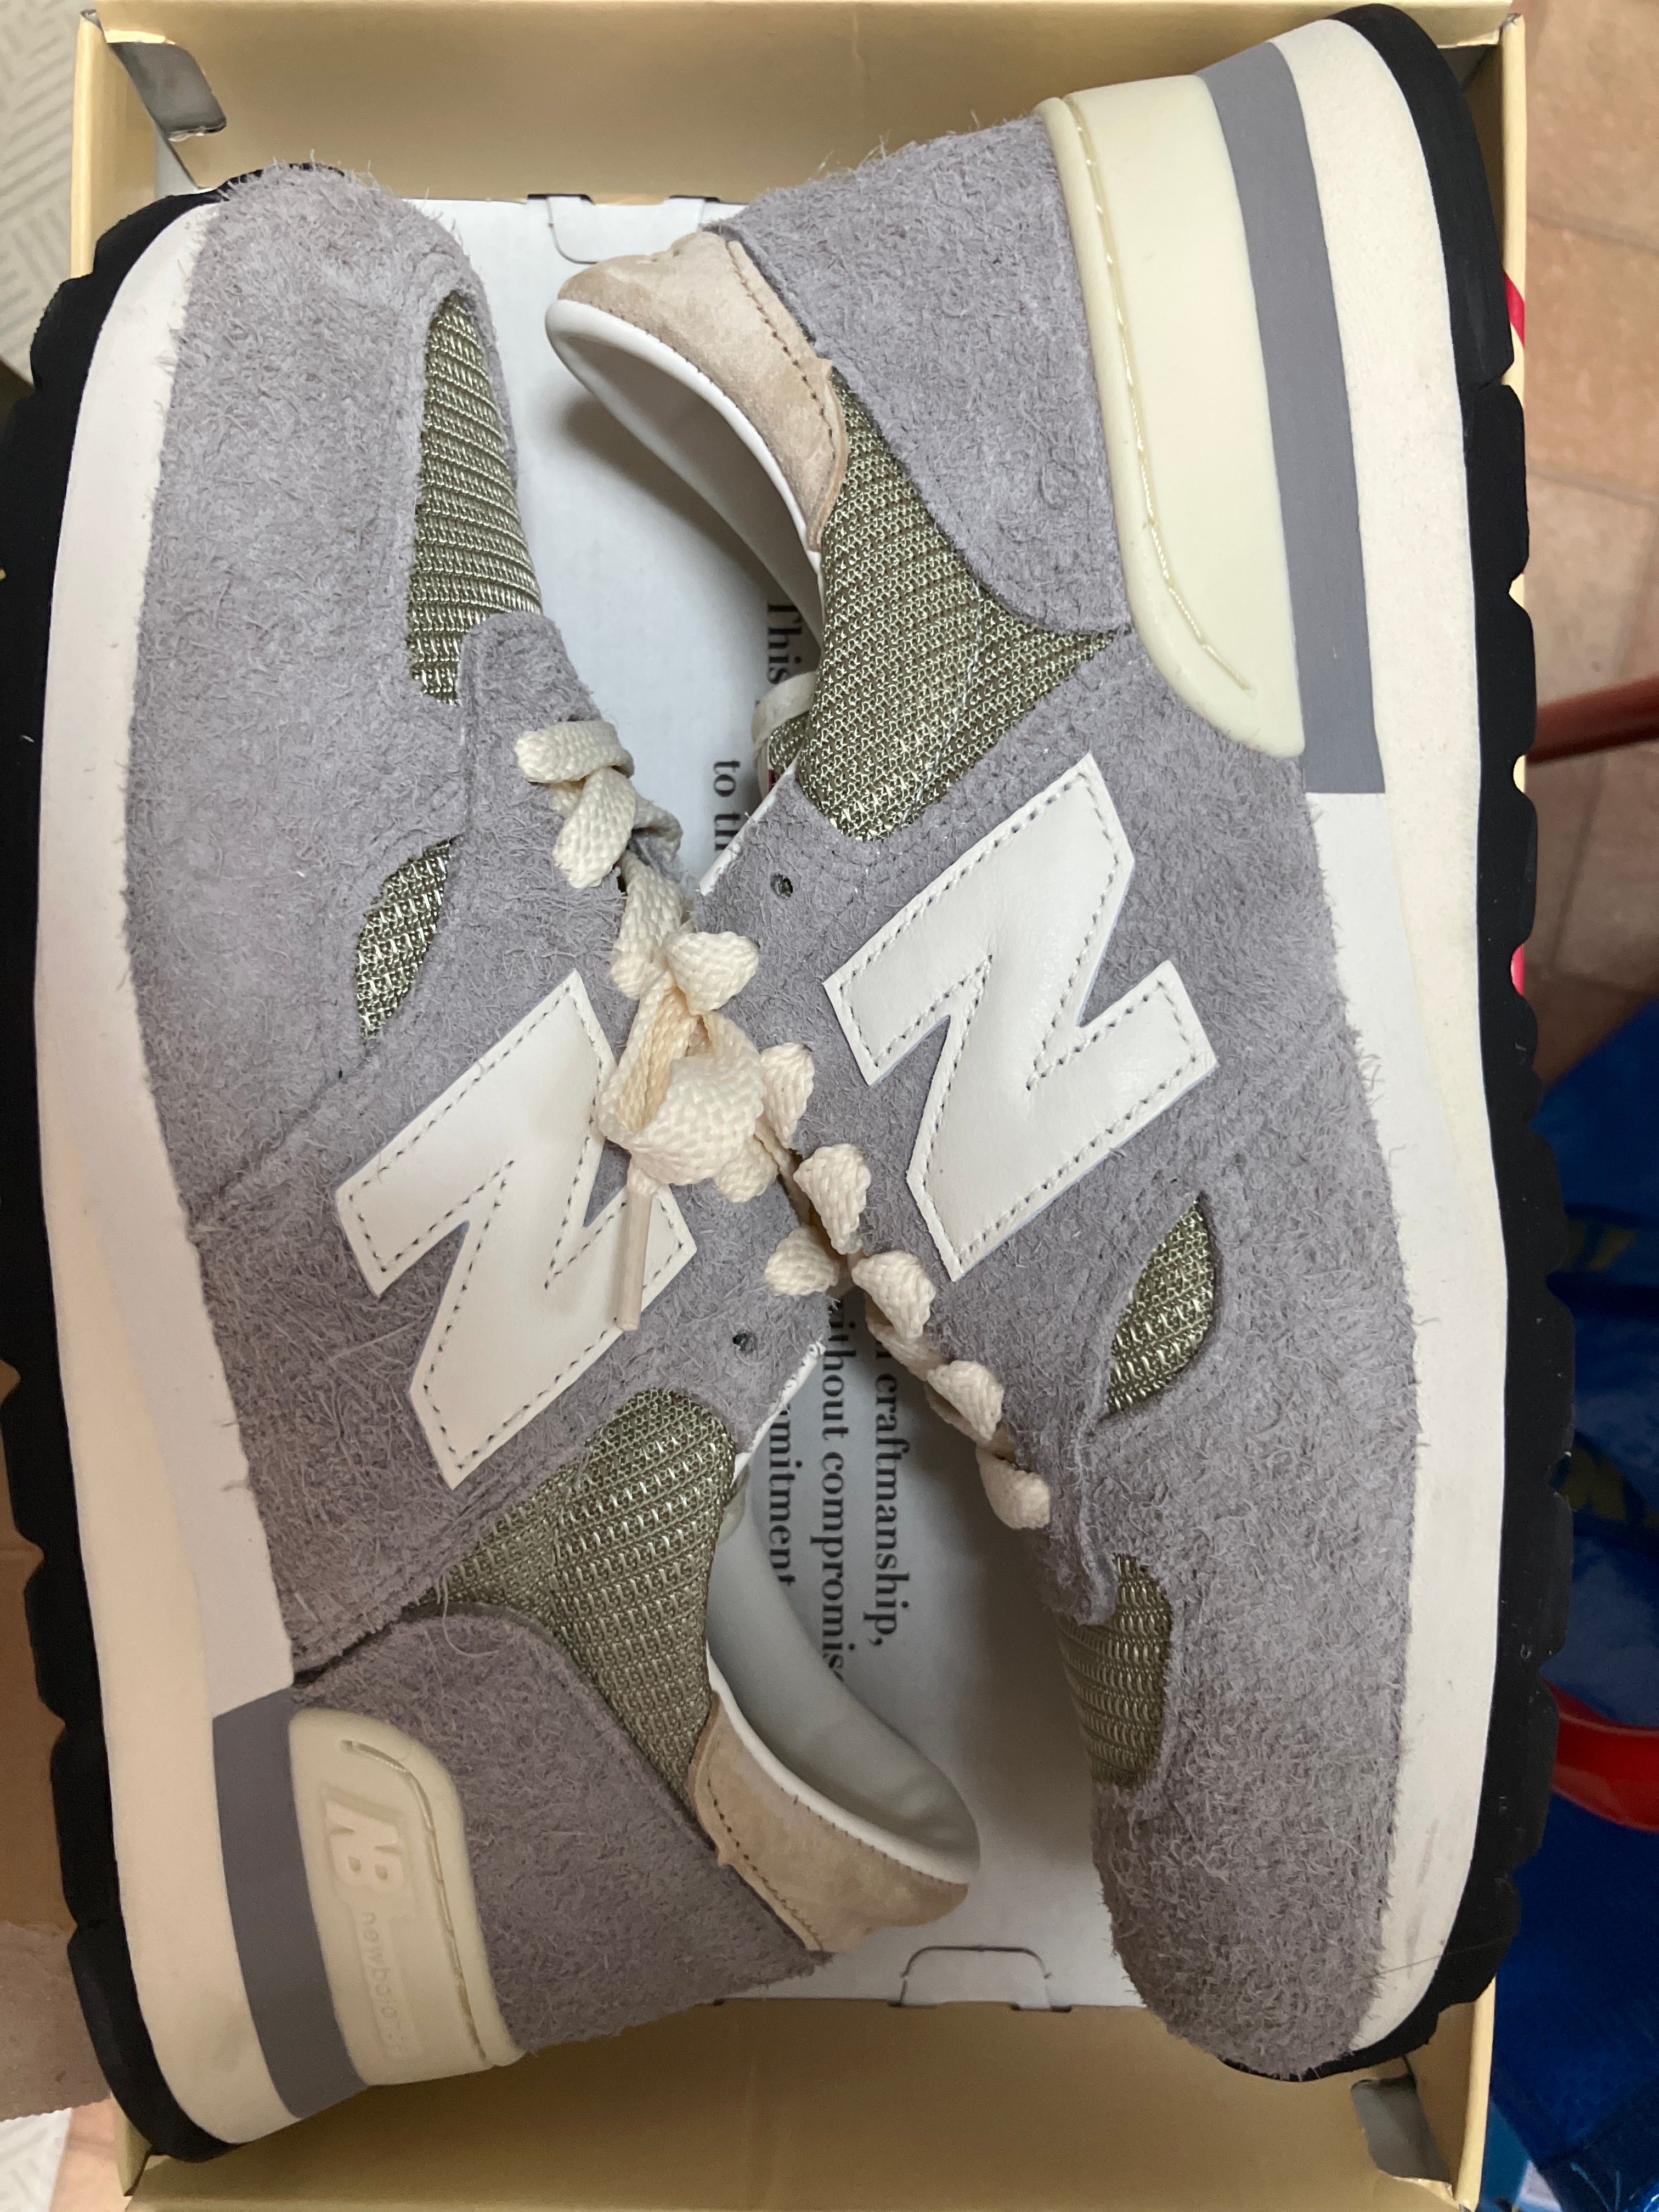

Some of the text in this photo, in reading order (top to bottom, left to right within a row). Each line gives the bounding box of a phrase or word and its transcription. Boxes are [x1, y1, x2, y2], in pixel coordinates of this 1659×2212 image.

[767, 604, 804, 685] This
[713, 760, 741, 798] to
[823, 753, 1218, 1282] N
[335, 969, 698, 1490] N
[768, 1405, 802, 1587] mitment
[810, 1451, 856, 1682] compromis
[864, 1373, 910, 1646] craftmanship,
